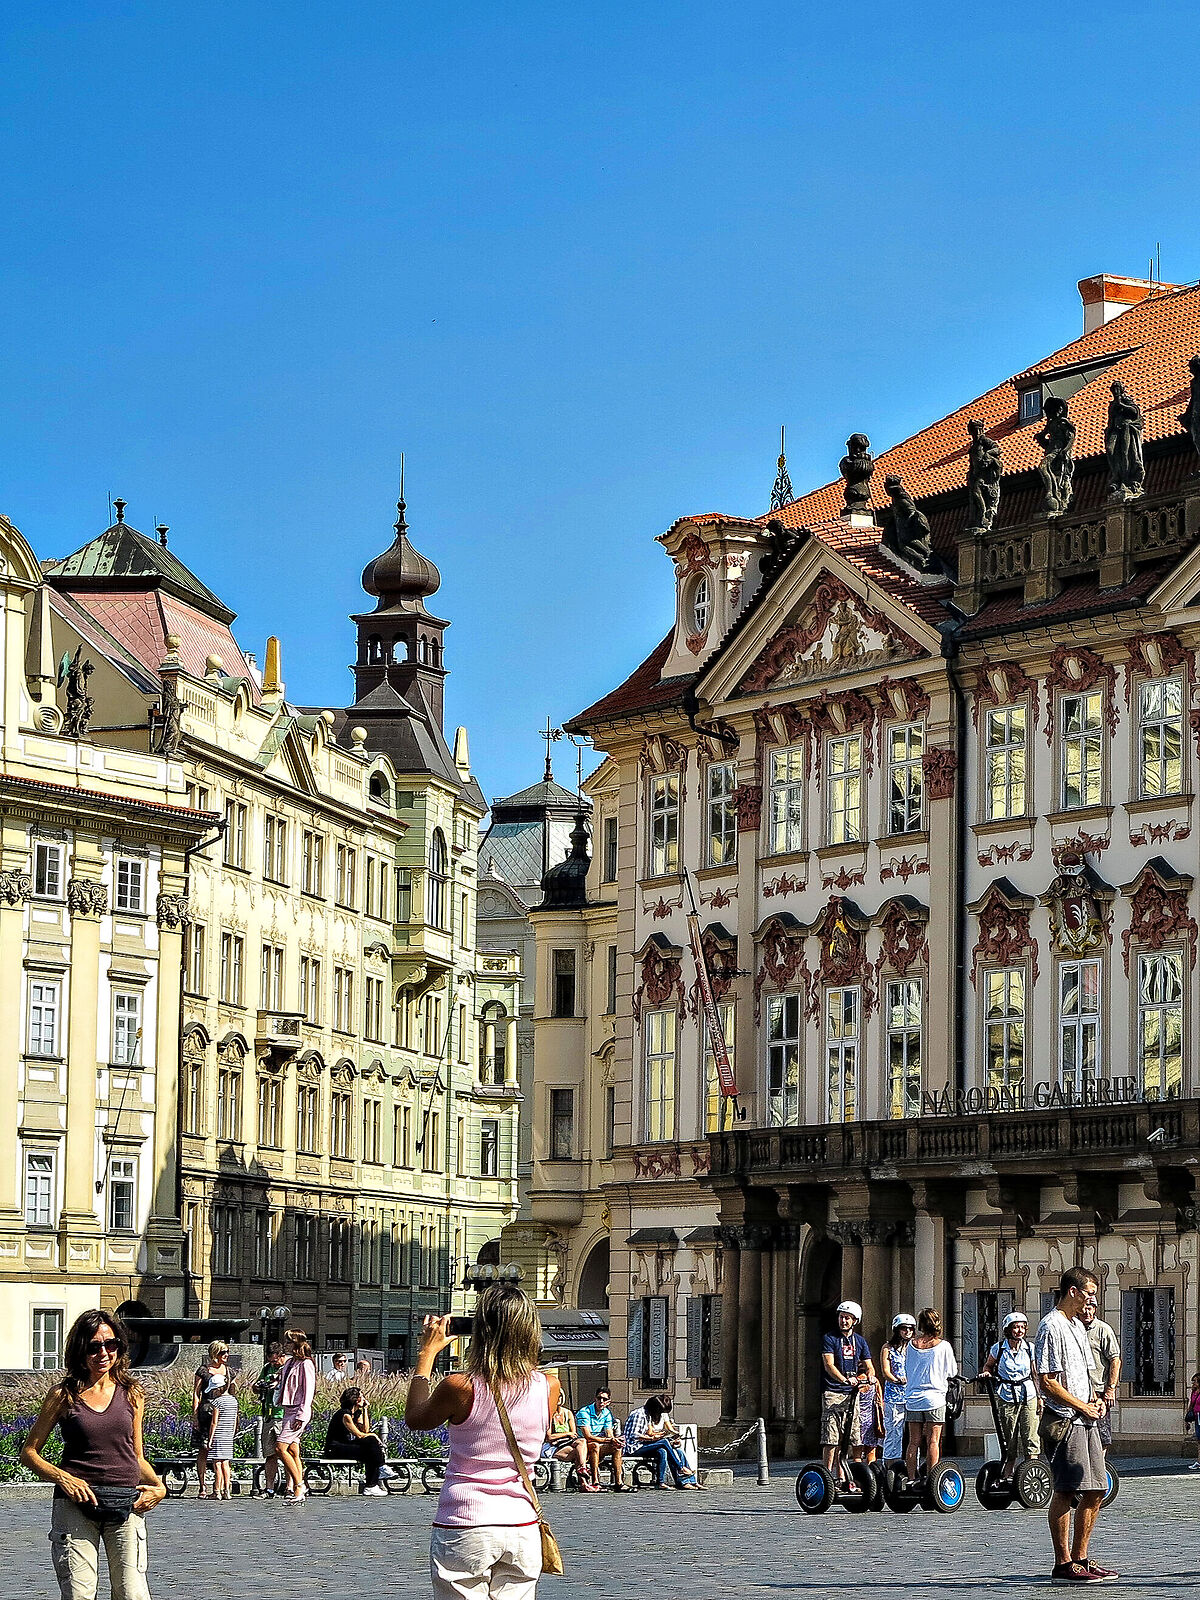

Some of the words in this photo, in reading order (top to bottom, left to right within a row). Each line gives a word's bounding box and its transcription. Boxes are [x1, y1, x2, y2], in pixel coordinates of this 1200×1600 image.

[921, 1076, 1026, 1115] NÁRODNÍ
[1033, 1075, 1139, 1108] GALERIE
[653, 1302, 661, 1346] GALERIE
[712, 1297, 722, 1346] GALERIE
